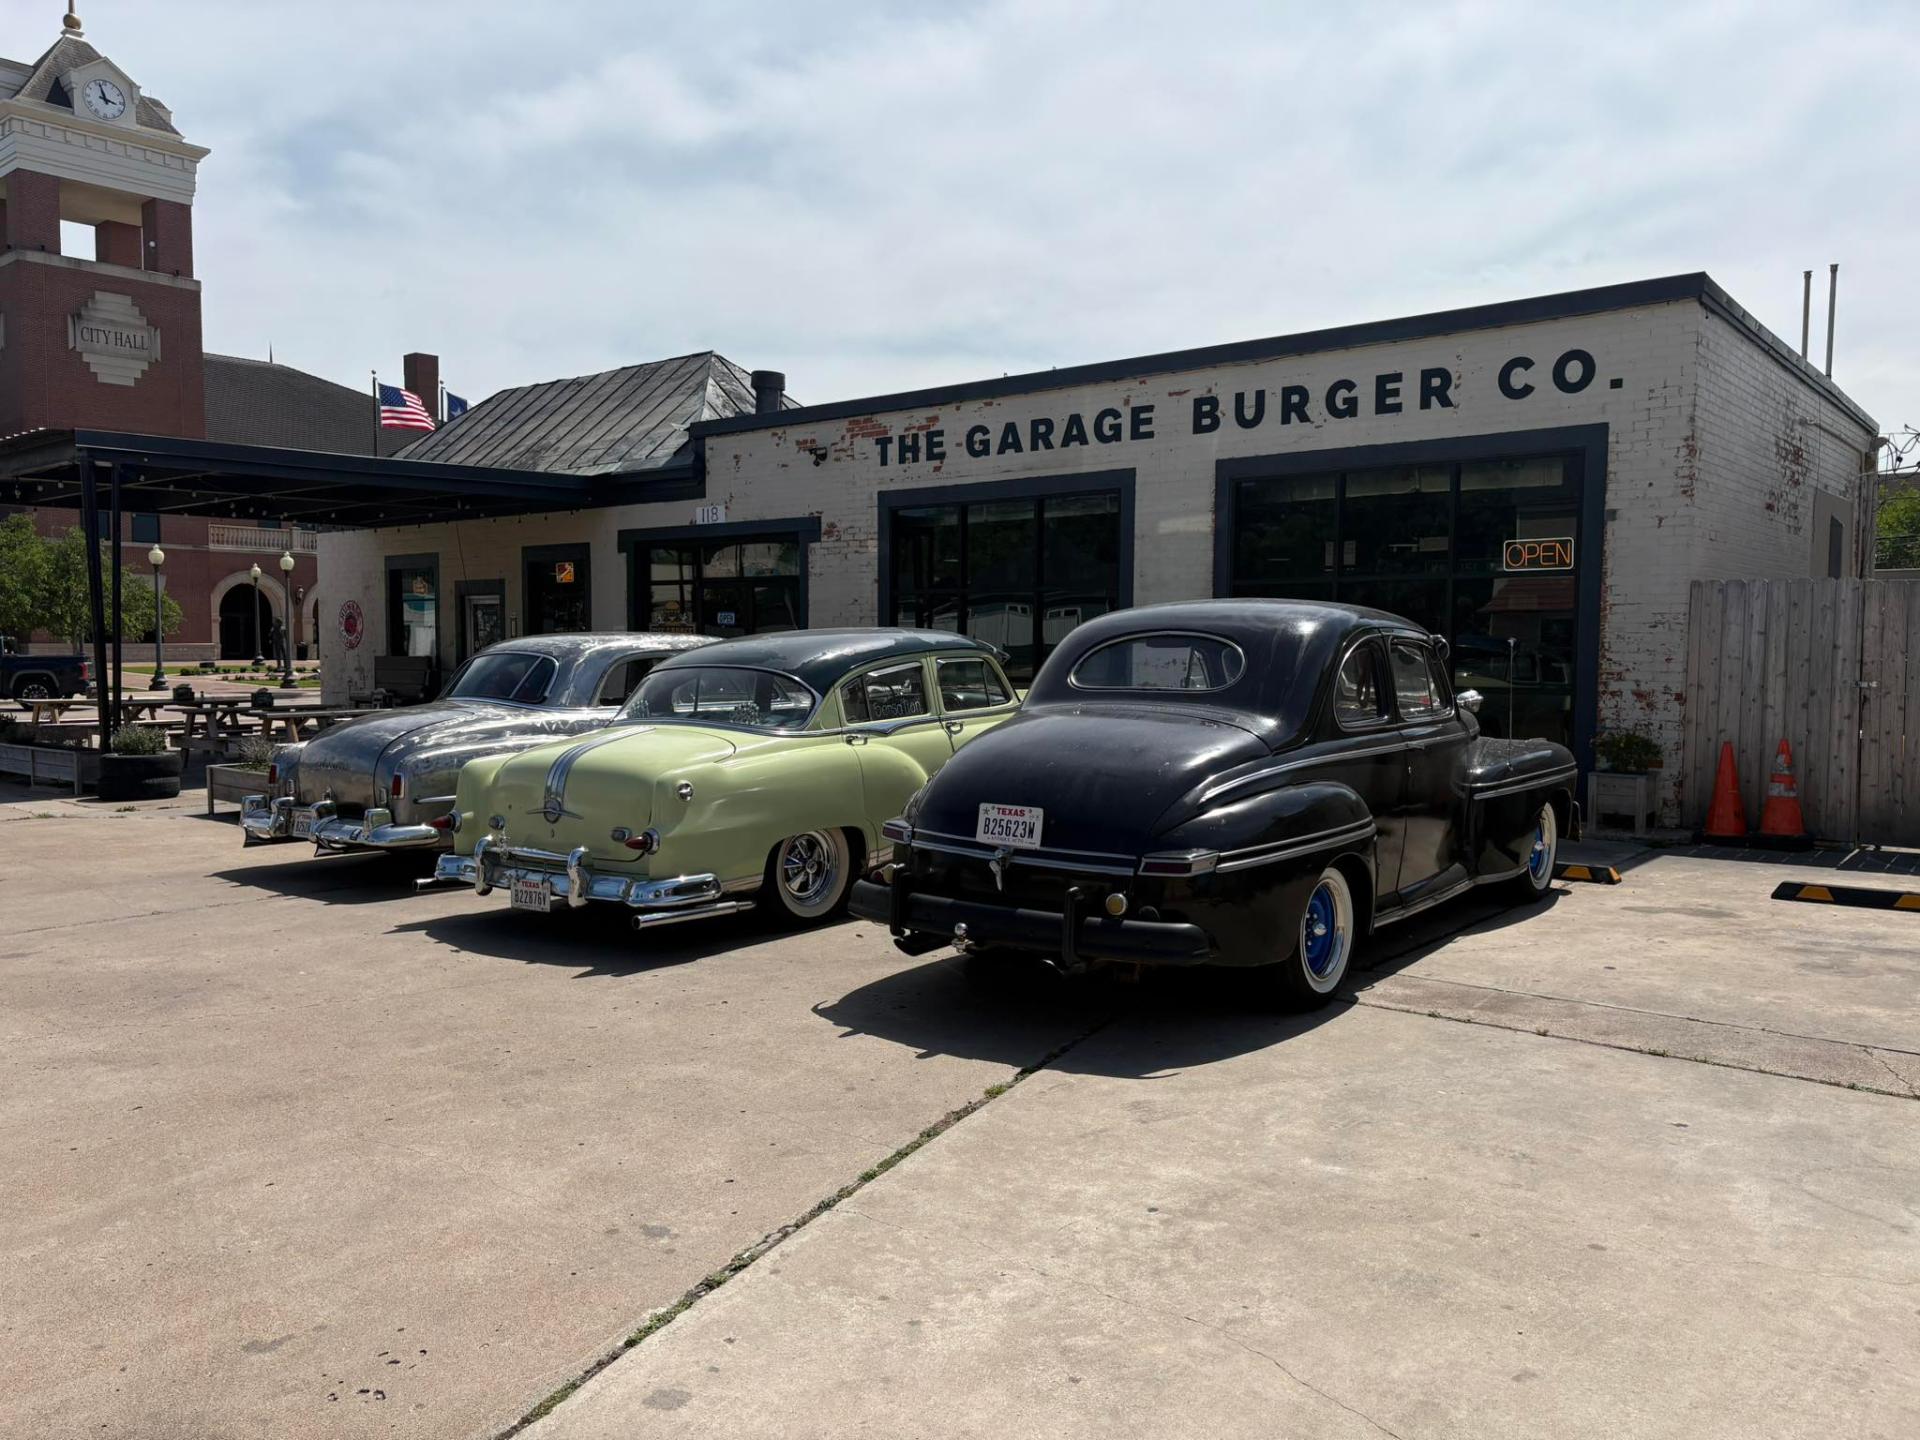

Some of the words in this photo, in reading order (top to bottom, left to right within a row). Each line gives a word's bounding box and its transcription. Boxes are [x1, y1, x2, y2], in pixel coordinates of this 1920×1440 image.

[80, 326, 111, 344] CITY
[114, 331, 149, 350] HALL
[875, 429, 946, 467] THE
[965, 404, 1155, 458] GARAGE
[1192, 367, 1455, 435] BURGER
[1497, 349, 1624, 400] CO.
[702, 506, 719, 523] 118
[1506, 541, 1571, 567] OPEN
[996, 807, 1026, 817] TEXAS
[521, 880, 541, 889] TEXAS
